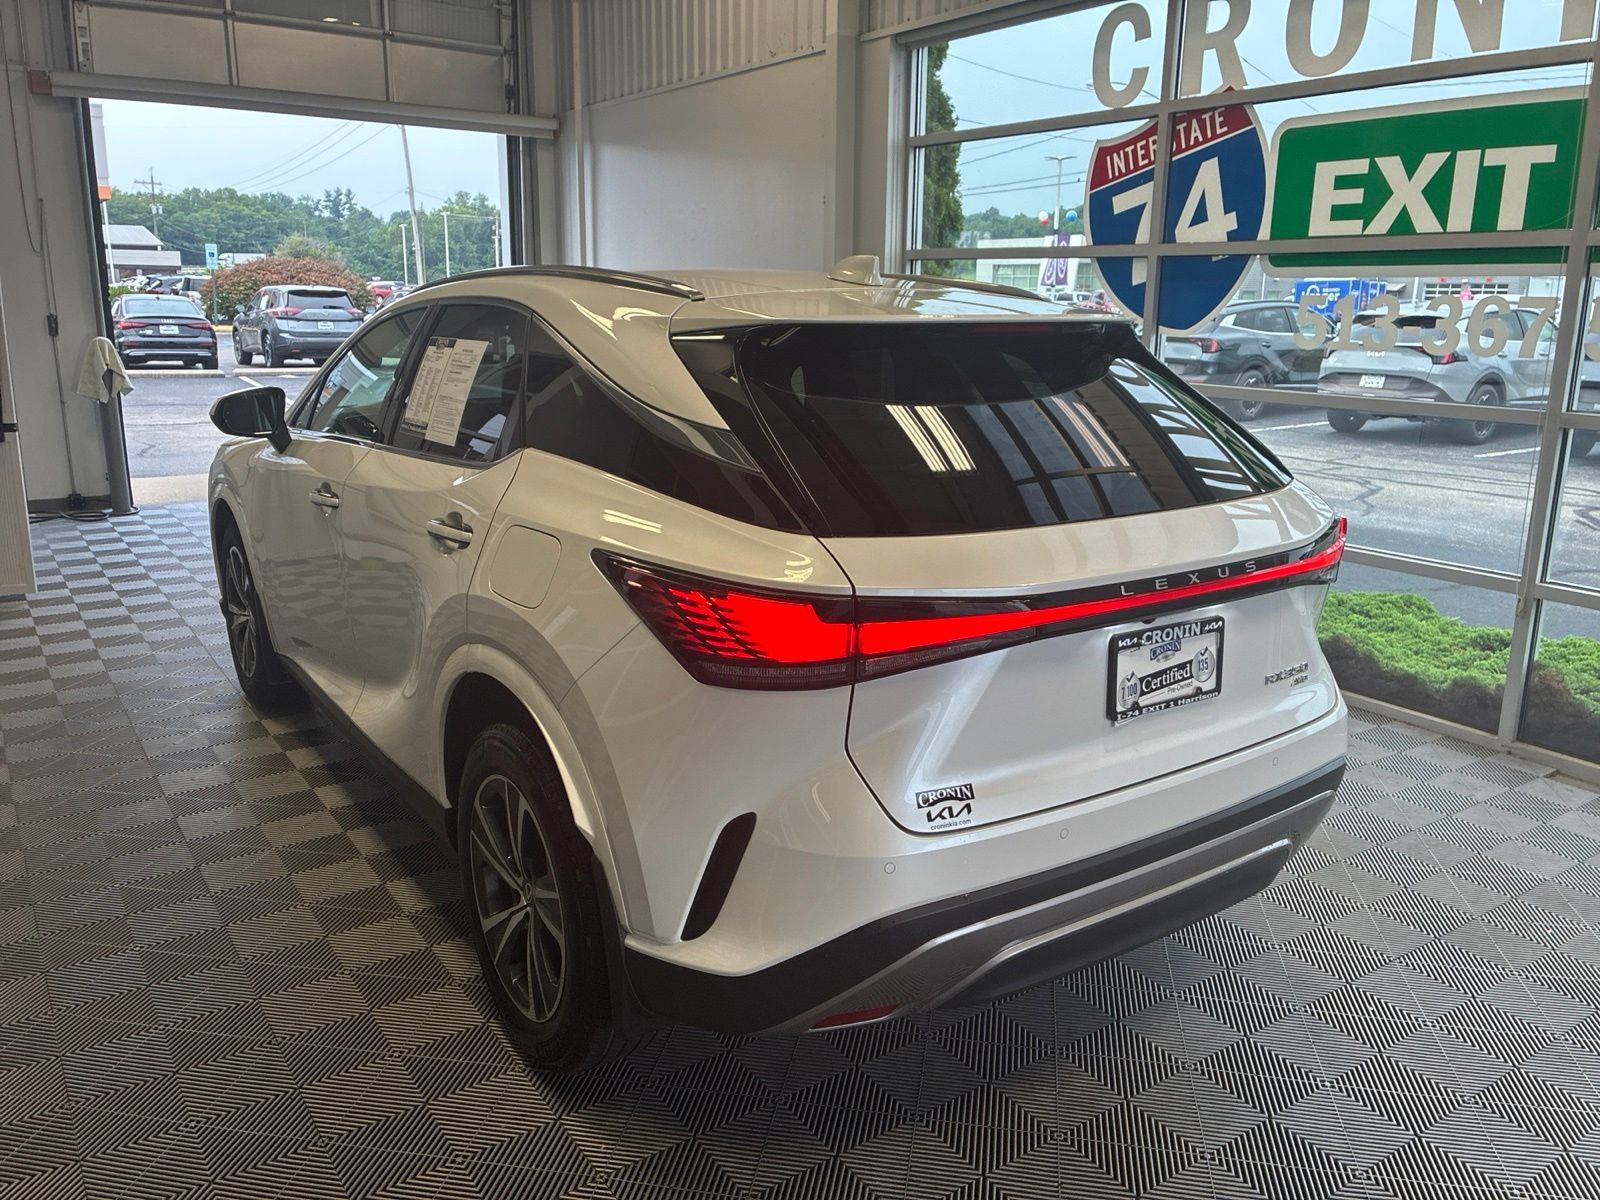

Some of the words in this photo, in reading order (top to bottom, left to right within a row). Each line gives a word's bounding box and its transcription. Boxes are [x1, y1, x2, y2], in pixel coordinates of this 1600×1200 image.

[1106, 108, 1229, 180] INTERTATE
[1308, 144, 1557, 237] EXIT
[1112, 156, 1239, 287] 74
[1120, 561, 1257, 596] LEXUS
[1141, 623, 1201, 645] CRONIN
[1150, 641, 1180, 659] CRONIN
[1142, 663, 1191, 692] Certified
[1117, 709, 1140, 720] I-74
[1142, 703, 1167, 714] EXIT
[1169, 701, 1175, 709] 1
[1178, 692, 1219, 706] Harrison
[918, 785, 972, 807] CRONIN
[930, 819, 972, 831] croninkia.com
